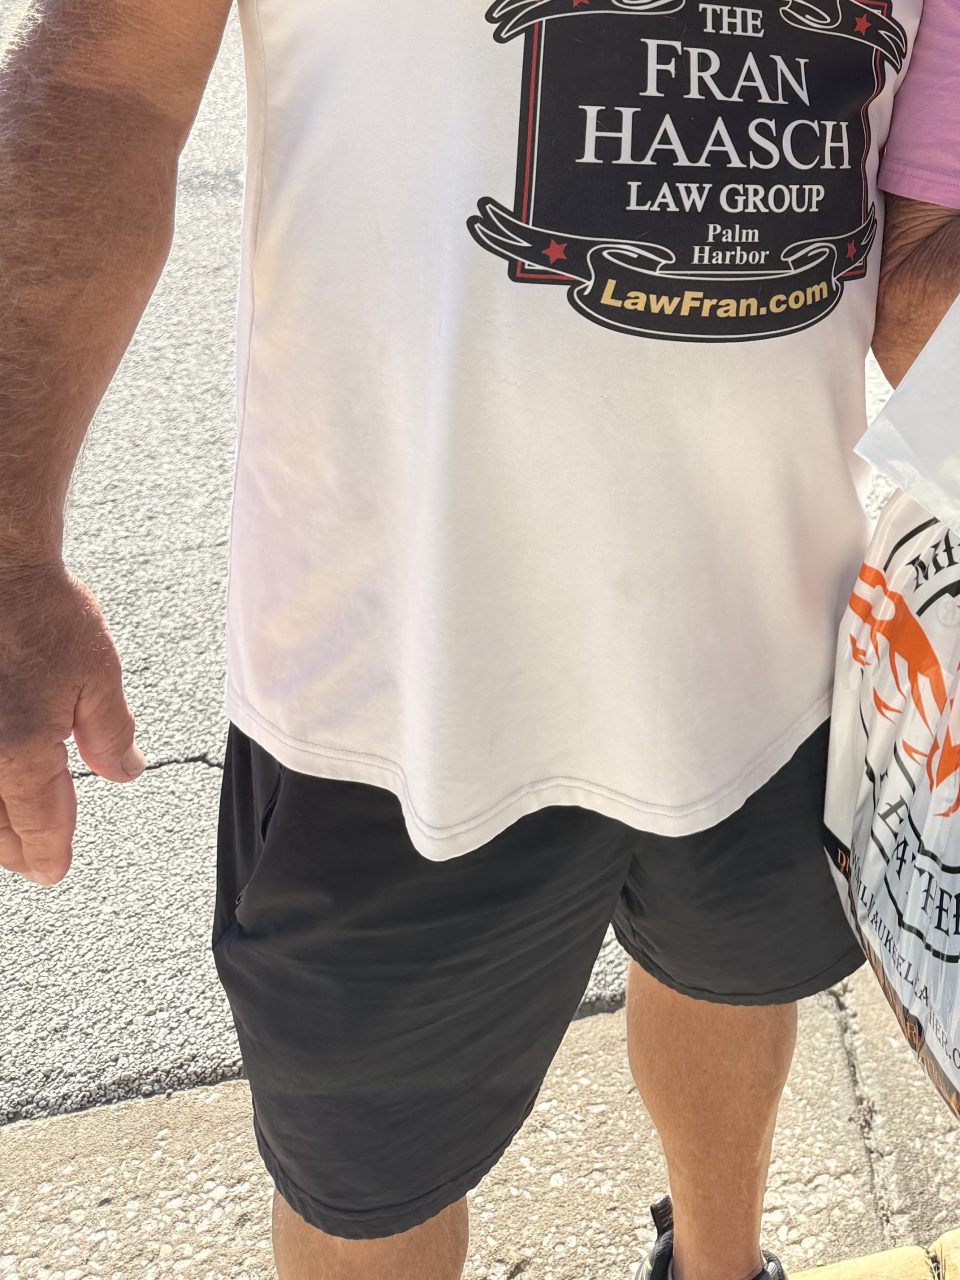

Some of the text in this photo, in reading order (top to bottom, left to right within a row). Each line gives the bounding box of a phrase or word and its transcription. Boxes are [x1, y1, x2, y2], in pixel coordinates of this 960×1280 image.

[698, 3, 765, 38] THE
[639, 38, 810, 107] FRAN
[575, 105, 852, 171] HAASCH
[626, 181, 826, 214] LAW GROUP
[706, 223, 760, 245] Palm
[691, 245, 770, 266] Harbor
[600, 278, 829, 319] LawFran.com
